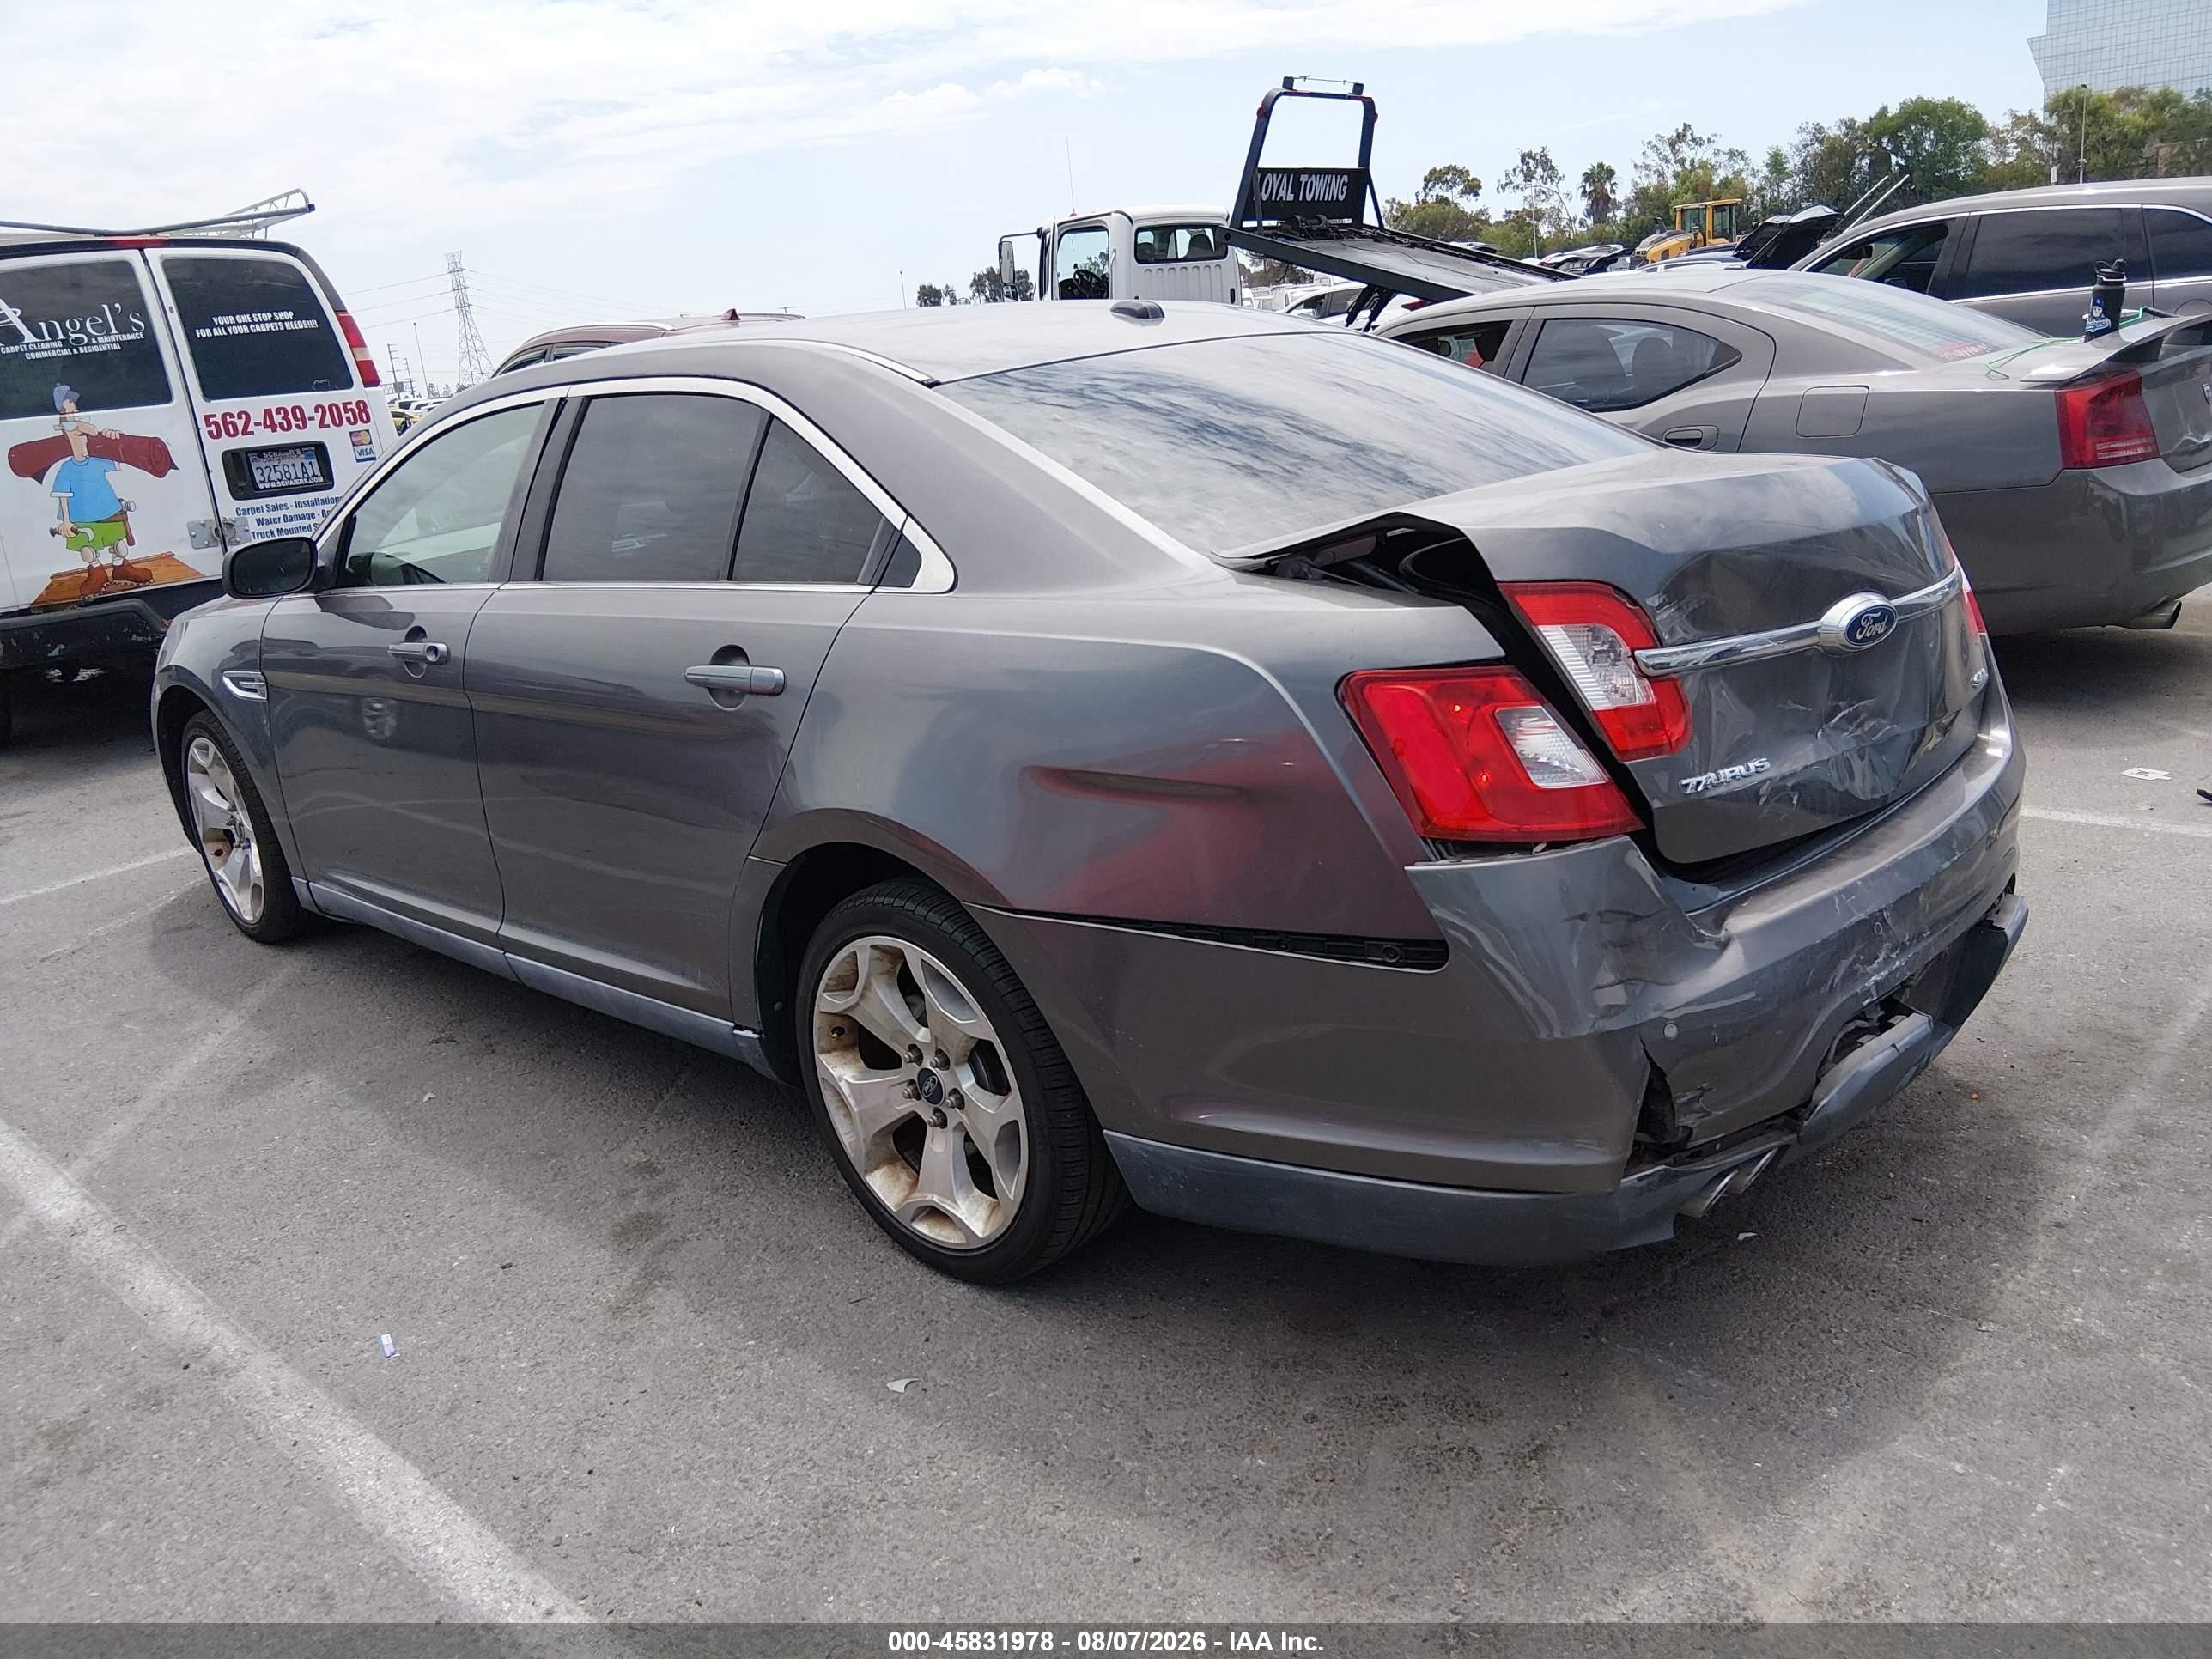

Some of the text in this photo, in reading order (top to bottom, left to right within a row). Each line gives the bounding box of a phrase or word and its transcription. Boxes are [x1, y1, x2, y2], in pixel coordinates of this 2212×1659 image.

[1298, 173, 1348, 202] TOWING
[212, 310, 294, 325] YOUR ONE STOP SHOP
[195, 328, 212, 338] FOR
[213, 326, 228, 337] ALL
[227, 325, 250, 335] YOUR
[250, 322, 284, 333] CARPETS
[0, 343, 27, 355] CARPET
[28, 340, 63, 351] CLEANING
[97, 331, 145, 343] MAINTENANCE
[25, 348, 72, 360] COMMERCIAL
[79, 343, 122, 354] RESIDENTIAL
[203, 399, 371, 440] 562-439-2058
[357, 447, 374, 457] VISA
[256, 460, 319, 483] 32581A1
[235, 506, 264, 517] Carpet
[264, 502, 289, 513] Sales
[255, 516, 282, 526] Water
[283, 511, 316, 520] Damage
[251, 529, 276, 540] Truck
[276, 524, 313, 536] Mounted
[1856, 611, 1889, 641] Ford
[1678, 757, 1771, 794] TAURUS
